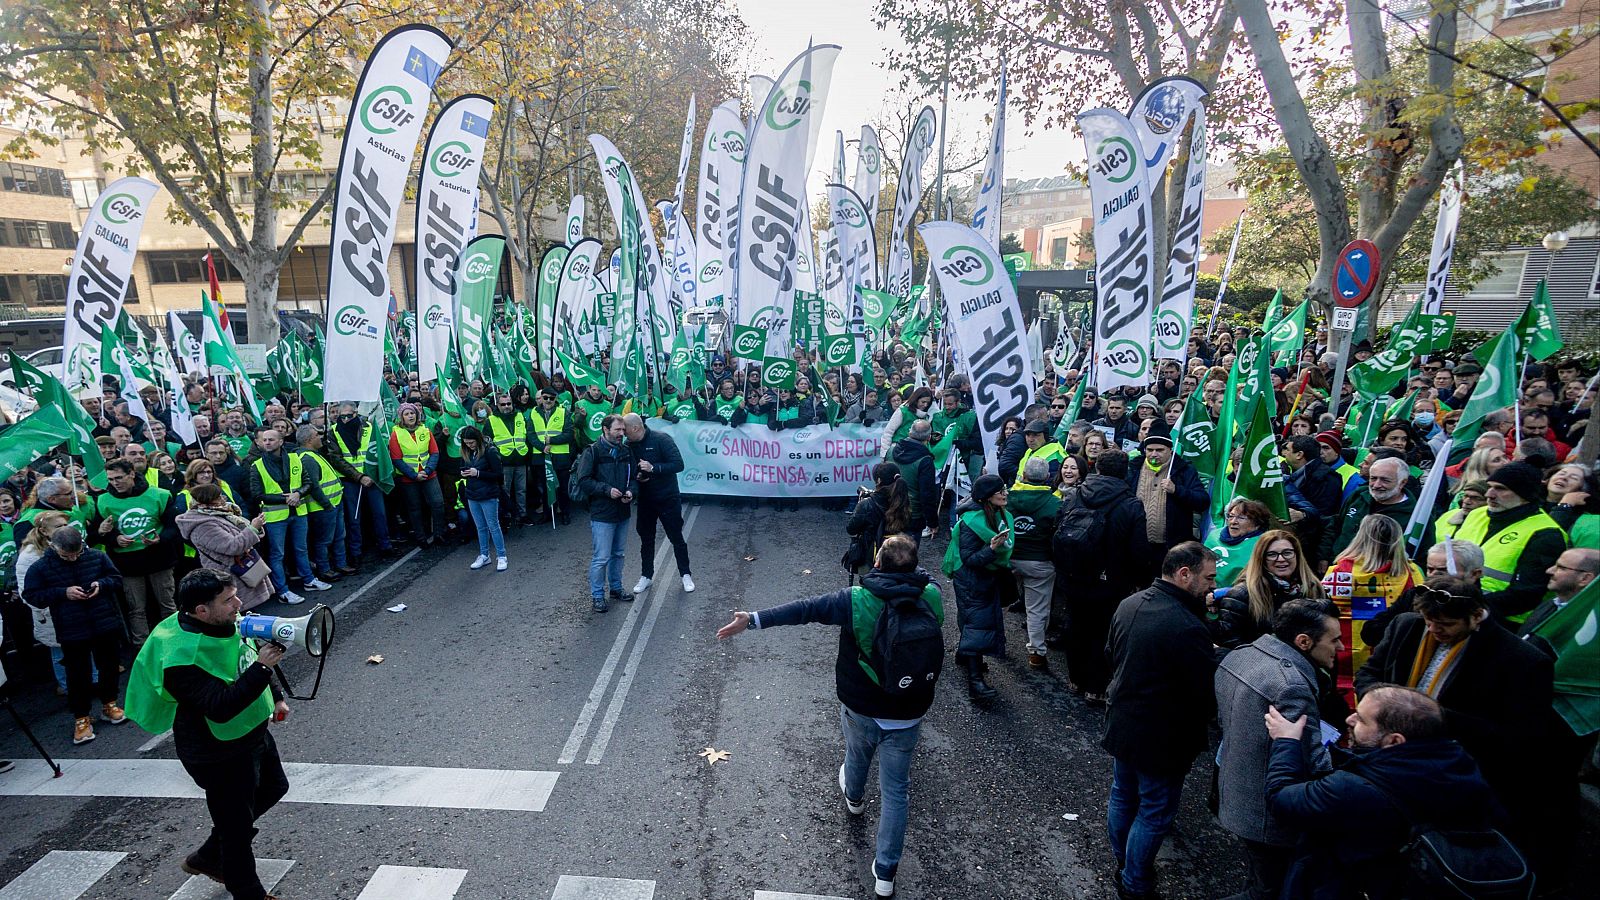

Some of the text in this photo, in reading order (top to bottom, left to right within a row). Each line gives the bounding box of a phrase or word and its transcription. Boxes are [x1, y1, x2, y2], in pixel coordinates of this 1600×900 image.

[372, 97, 415, 130] CSIF
[777, 96, 817, 116] CSIF
[367, 136, 406, 163] Asturias
[439, 150, 474, 170] CSIF
[439, 180, 471, 195] Asturias
[111, 200, 142, 220] CSIF
[341, 147, 391, 297] CSIF
[749, 163, 798, 291] CSIF
[95, 224, 129, 249] GALICIA
[424, 189, 465, 296] CSIF
[468, 261, 494, 275] CSIF
[73, 237, 125, 342] CSIF
[340, 312, 369, 329] CSIF
[1337, 311, 1352, 319] GIRO
[740, 338, 763, 349] CSIF
[831, 344, 852, 355] CSIF
[769, 368, 792, 379] CSIF
[705, 444, 718, 455] La
[722, 437, 781, 459] SANIDAD
[789, 452, 802, 460] es
[806, 452, 821, 460] un
[1185, 429, 1211, 453] CSIF
[706, 472, 725, 481] por
[728, 471, 739, 481] la
[743, 463, 807, 484] DEFENSA
[814, 473, 829, 484] de
[122, 516, 152, 528] CSIF
[1014, 521, 1036, 531] CSIF
[280, 628, 294, 637] CSIF
